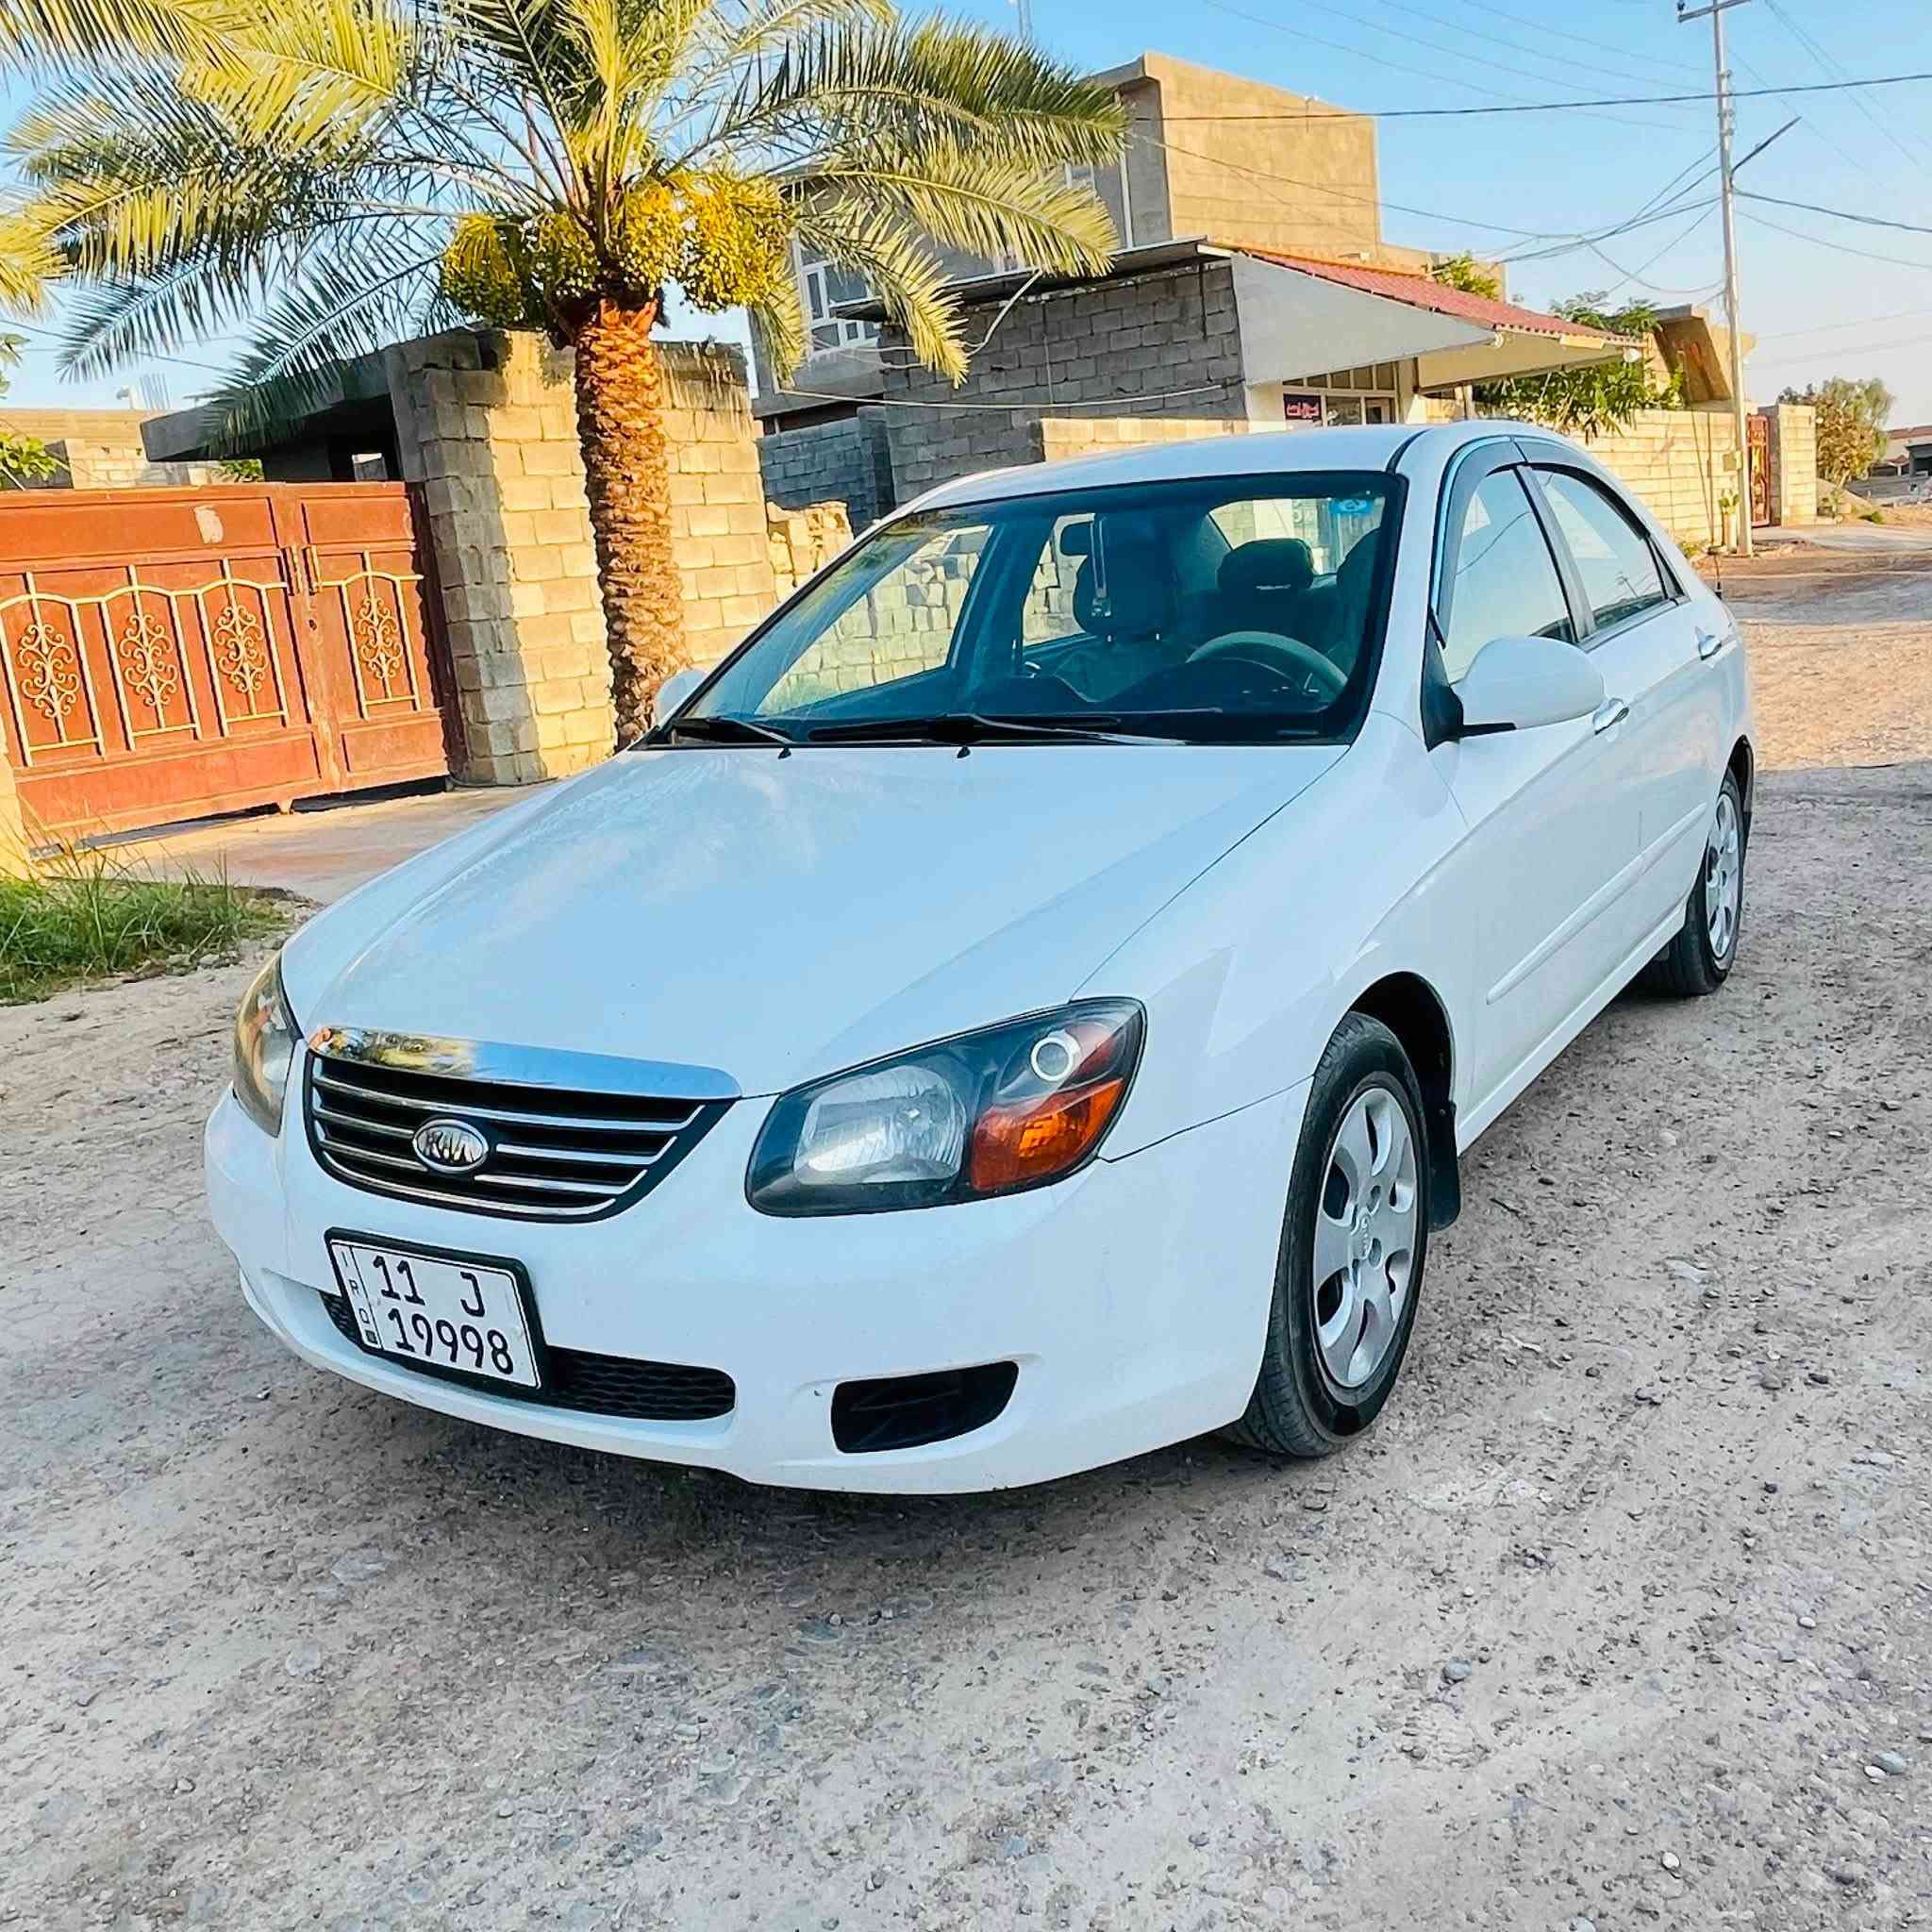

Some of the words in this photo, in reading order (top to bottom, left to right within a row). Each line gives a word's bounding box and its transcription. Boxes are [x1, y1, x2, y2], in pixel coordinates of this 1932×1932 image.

[419, 1129, 481, 1163] KIA
[373, 1255, 425, 1306] 11
[459, 1271, 486, 1317] J
[387, 1307, 514, 1375] 19998
